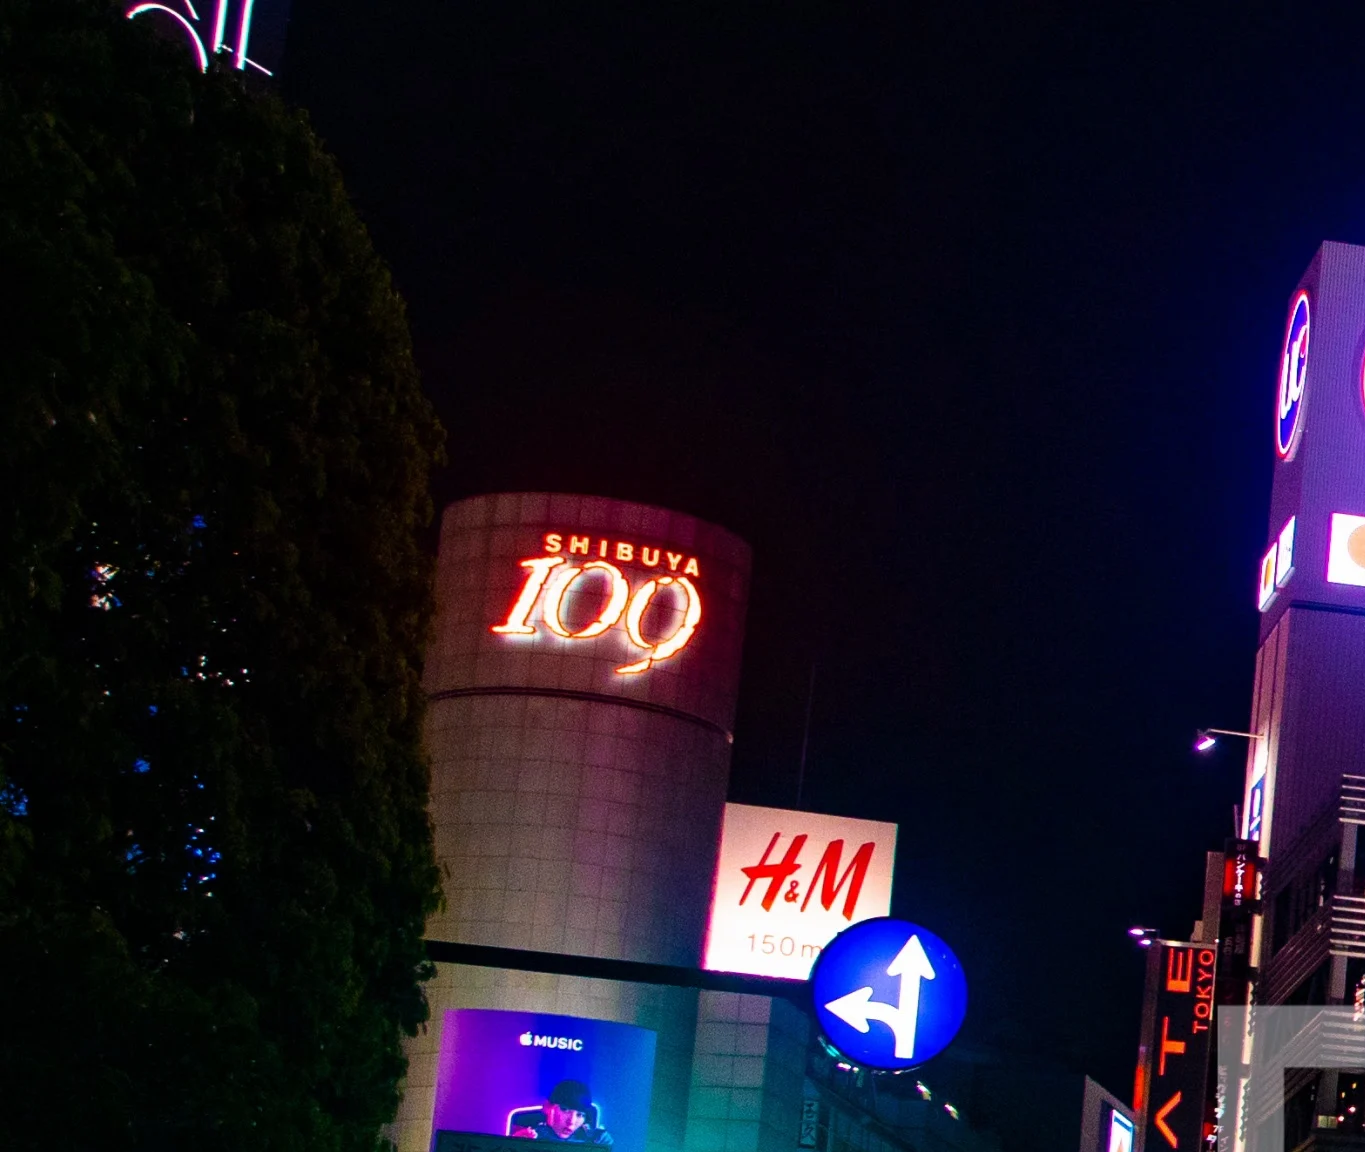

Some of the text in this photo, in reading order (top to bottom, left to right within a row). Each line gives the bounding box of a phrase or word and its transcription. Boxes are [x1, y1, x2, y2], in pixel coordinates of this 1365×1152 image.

[545, 533, 699, 577] SHIBUYA
[490, 556, 702, 675] 109
[740, 831, 876, 922] H&M
[1192, 950, 1215, 1034] TOKYO
[533, 1034, 583, 1051] MUSIC
